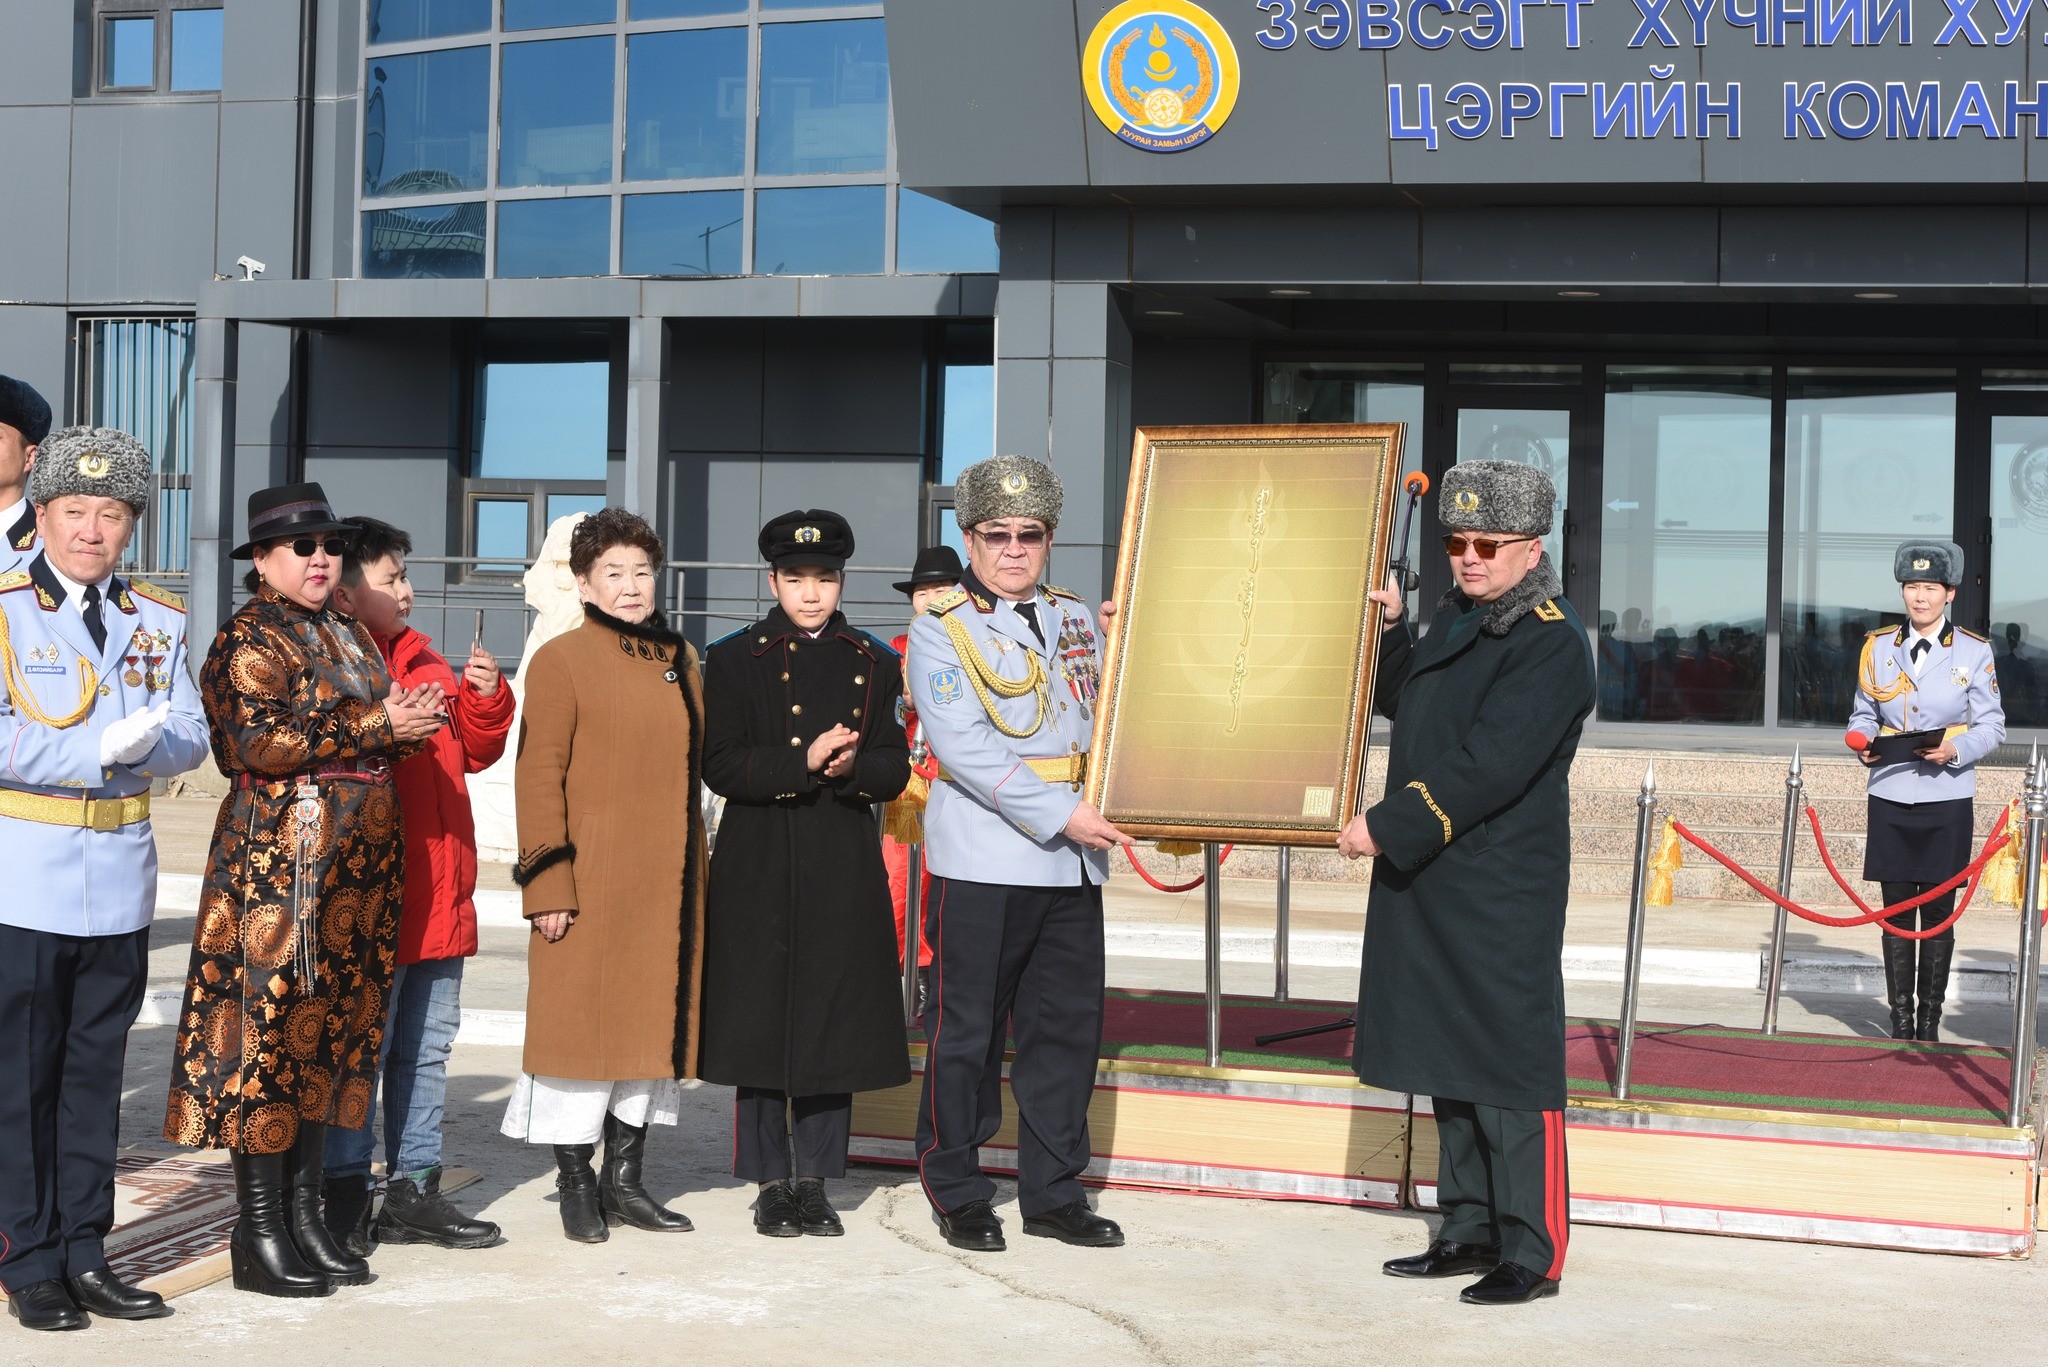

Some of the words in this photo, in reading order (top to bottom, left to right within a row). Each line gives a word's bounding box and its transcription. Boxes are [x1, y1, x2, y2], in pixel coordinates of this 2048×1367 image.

[1256, 0, 1594, 49] ЗЭВСЭГТ
[1934, 0, 2048, 46] ХУ
[1388, 64, 1741, 150] ЦЭРГИЙН
[1121, 128, 1151, 145] ХУУРАЙ
[1152, 138, 1183, 148] ЗАМЫН
[1184, 127, 1207, 144] ЦЭРЭГ
